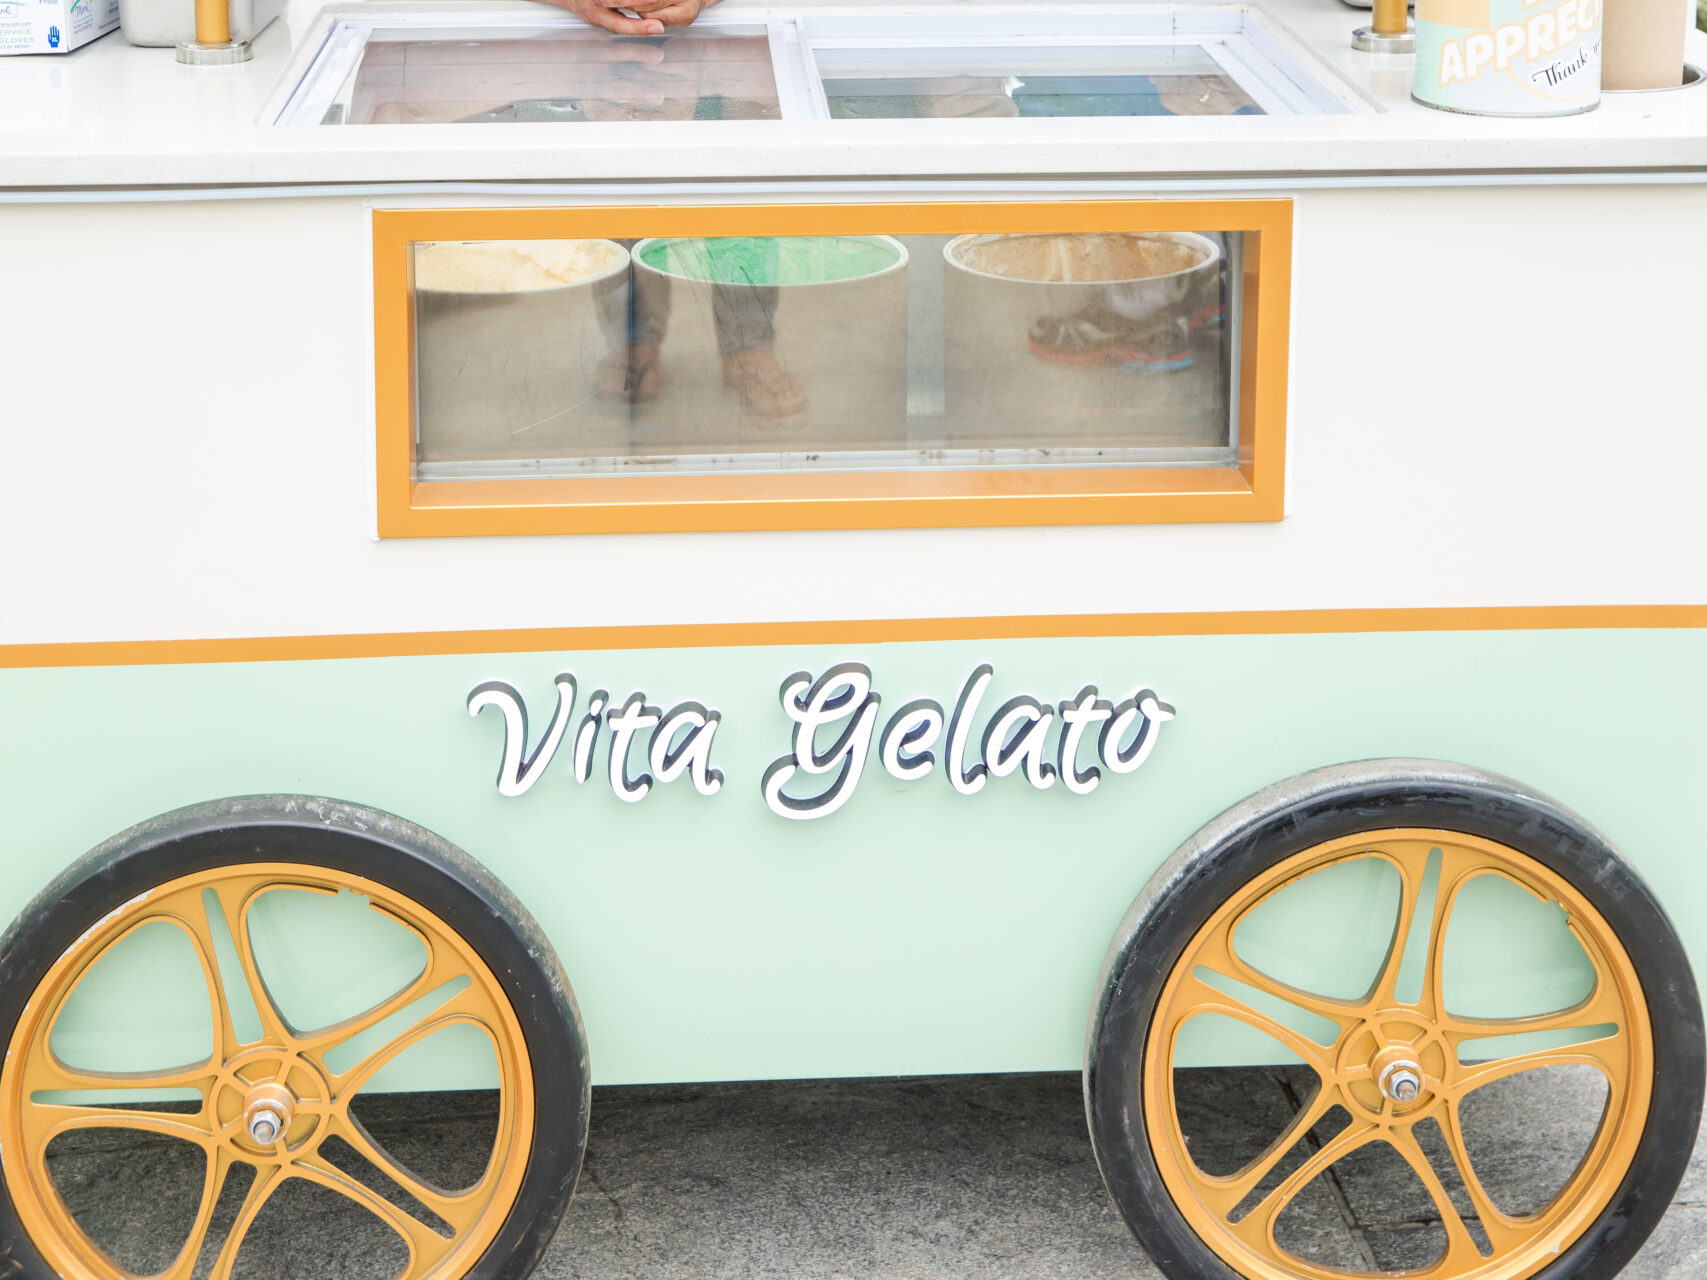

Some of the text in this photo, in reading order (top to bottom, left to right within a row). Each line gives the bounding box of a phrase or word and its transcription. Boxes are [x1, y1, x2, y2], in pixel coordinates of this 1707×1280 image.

[1532, 45, 1589, 87] Thank
[467, 661, 1177, 821] Vita Gelato
